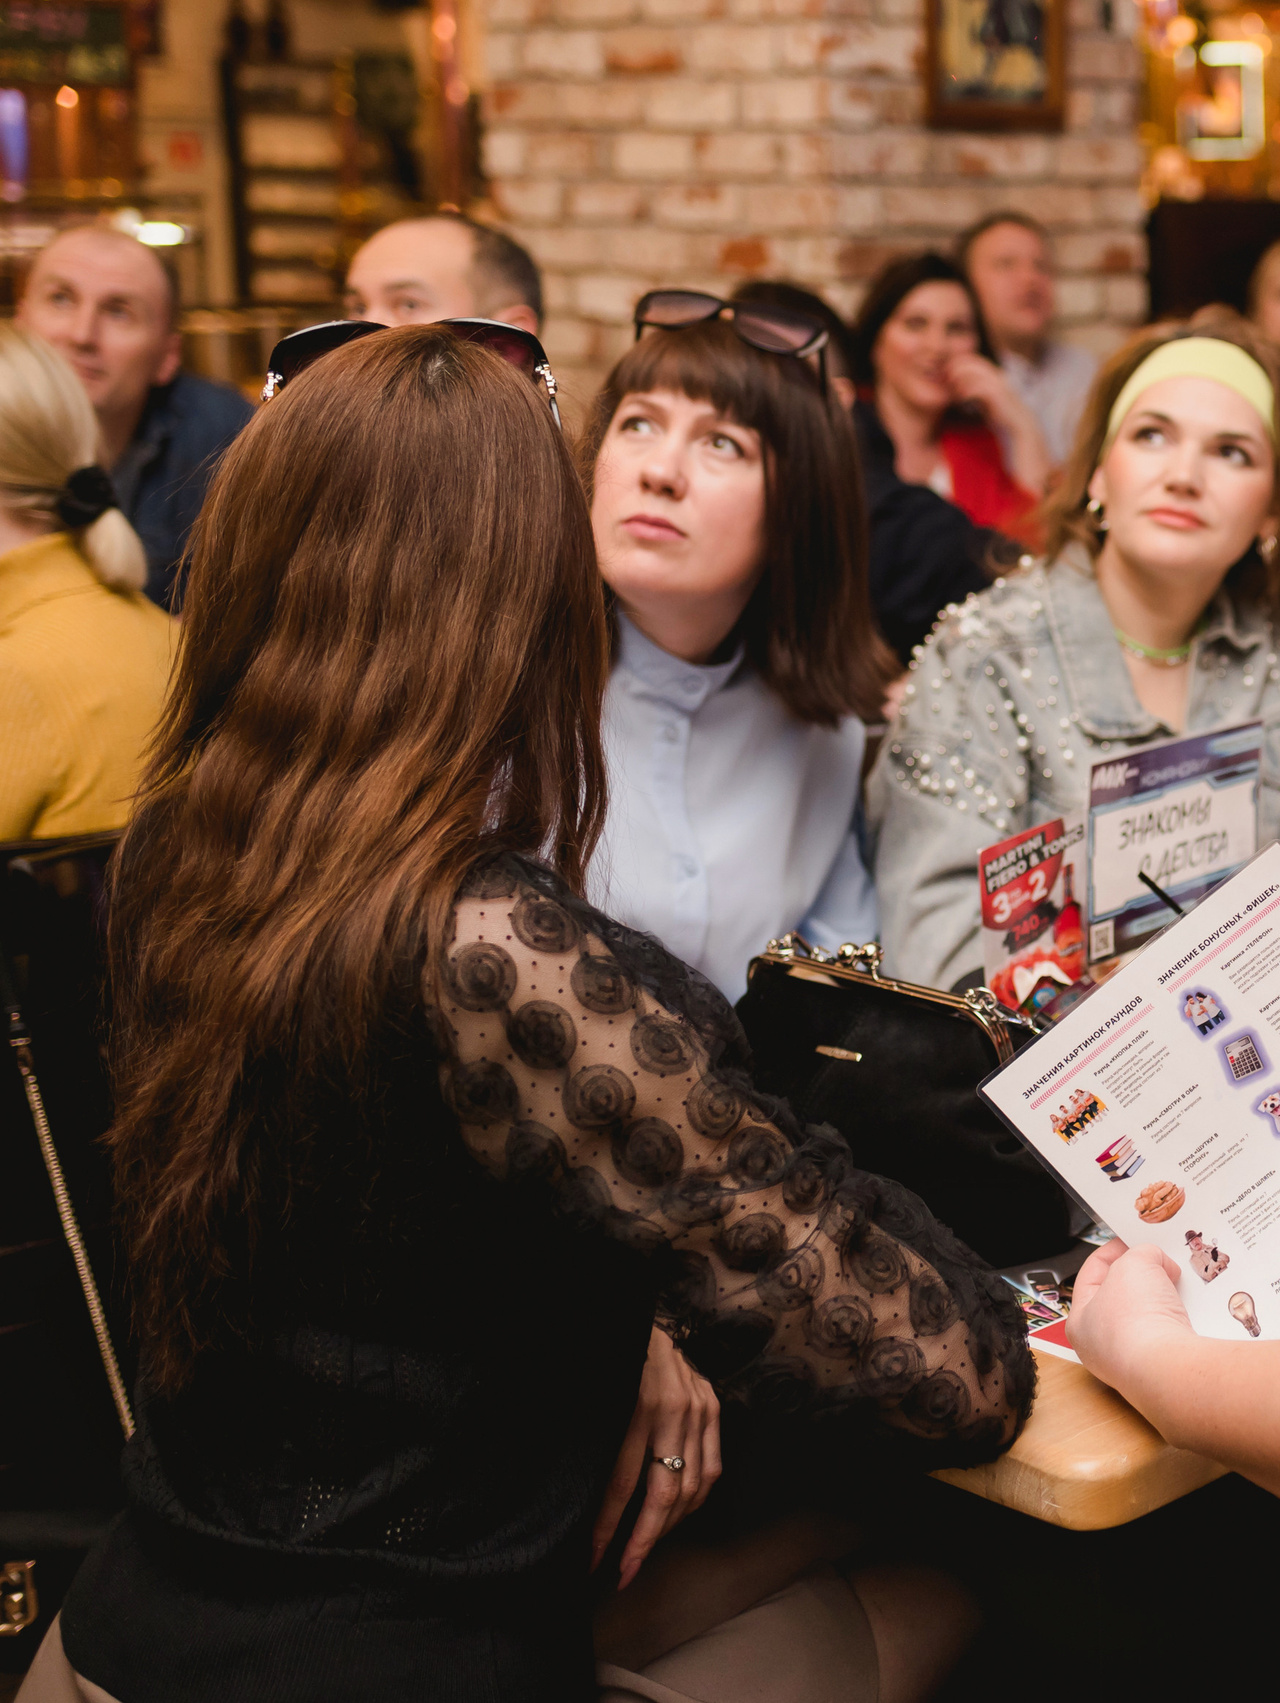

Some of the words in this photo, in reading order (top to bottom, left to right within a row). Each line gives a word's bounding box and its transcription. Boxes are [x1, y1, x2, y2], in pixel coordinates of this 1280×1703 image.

[1118, 796, 1212, 850] ЗНАКОМЫ
[984, 833, 1044, 878] MARTINI
[986, 859, 1028, 894] FIERO
[1154, 830, 1229, 888] ДЕТСТВА
[992, 891, 1012, 923] 3
[1028, 869, 1049, 902] 2
[1012, 914, 1040, 942] 740
[1157, 948, 1200, 985] ЗНАЧЕНИЕ
[1198, 913, 1243, 951] БОНУСНЫХ
[1242, 883, 1280, 915] «ФИШЕК»
[1220, 950, 1245, 971] Картинка
[1245, 927, 1273, 951] «ТЕЛЕФОН»
[1022, 1062, 1065, 1099] ЗНАЧЕНИЯ
[1063, 1026, 1107, 1064] КАРТИНОК
[1104, 995, 1144, 1030] РАУНДОВ
[1093, 1063, 1110, 1077] Раунд
[1109, 1043, 1133, 1064] «КНОПКА
[1131, 1029, 1149, 1045] ПЛЕЙ»
[1143, 1117, 1159, 1131] Раунд
[1158, 1097, 1182, 1118] «СМОТРИ
[1185, 1083, 1199, 1095] ОБА»
[1178, 1153, 1195, 1167] Раунд
[1194, 1136, 1215, 1155] «ШУТКИ
[1183, 1151, 1210, 1173] СТОРОНУ»
[1220, 1201, 1236, 1215] Раунд
[1235, 1188, 1252, 1203] «ДЕЛО
[1255, 1169, 1276, 1187] ШЛЯПЕ»
